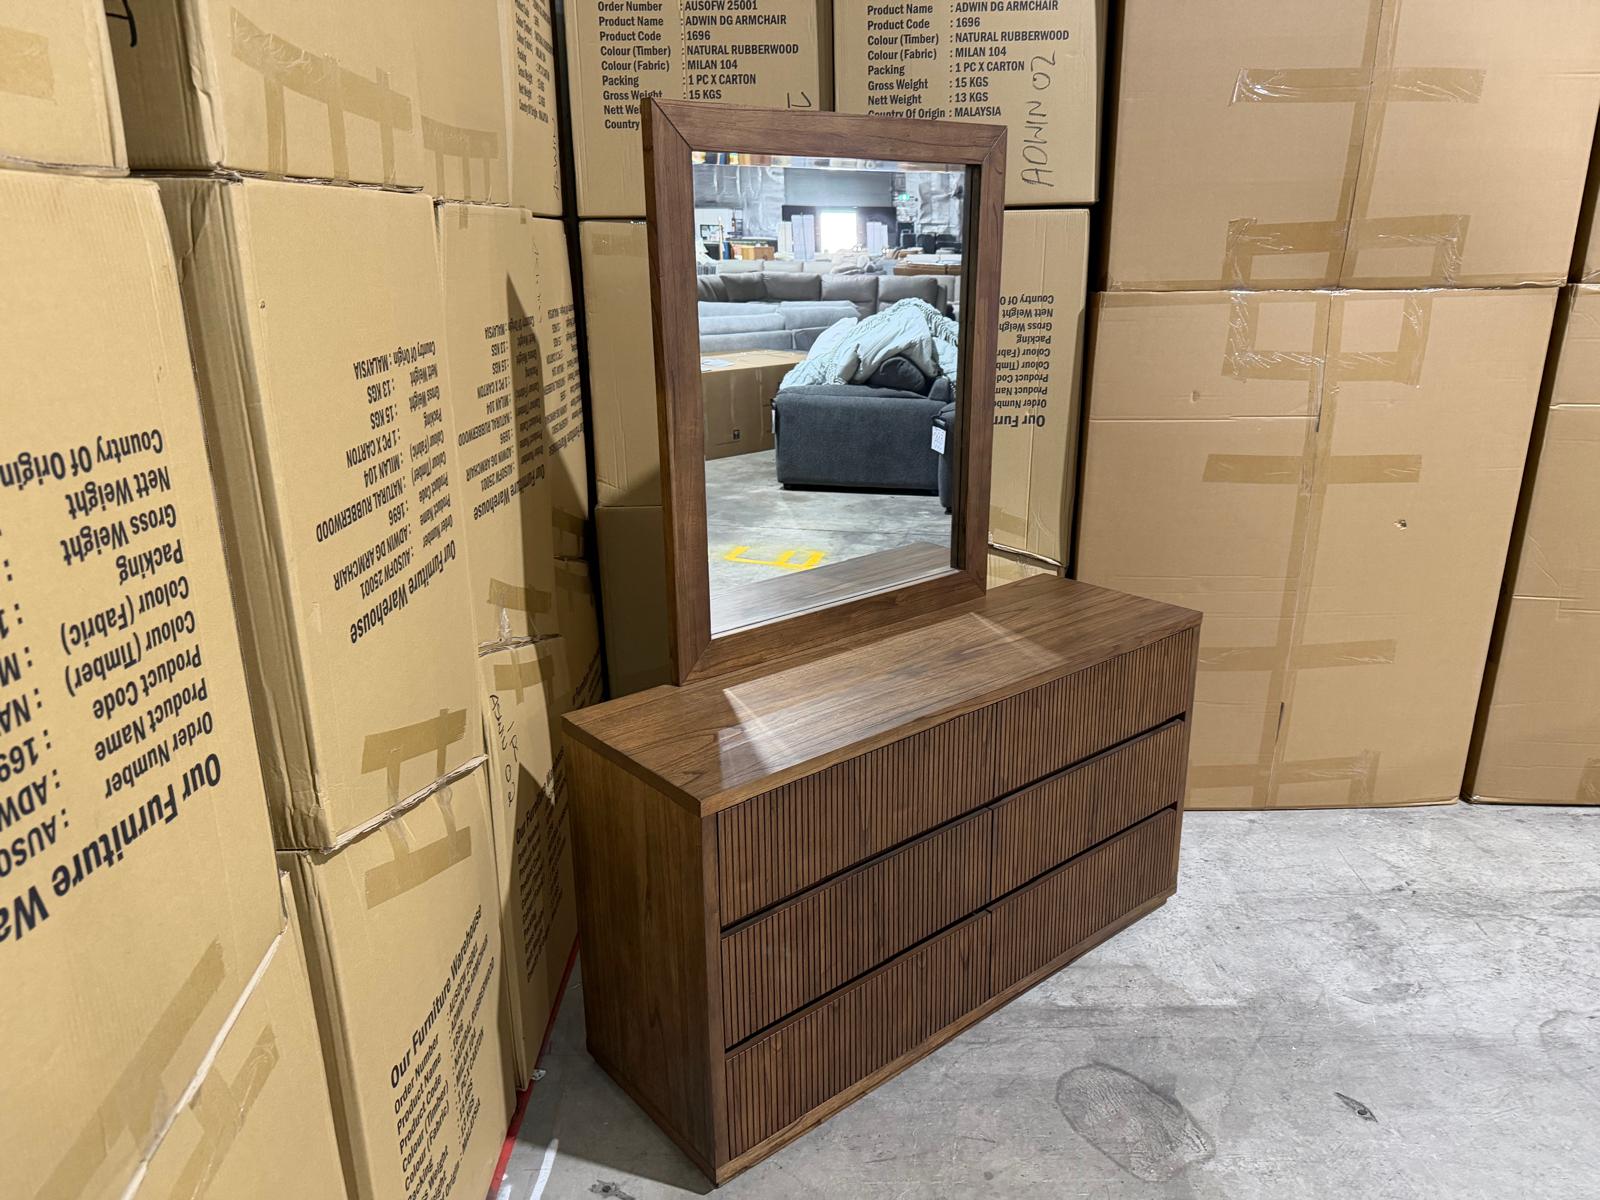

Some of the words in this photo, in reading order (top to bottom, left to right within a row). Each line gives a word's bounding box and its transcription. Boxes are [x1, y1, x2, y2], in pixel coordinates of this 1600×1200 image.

[598, 1, 624, 11] Order
[626, 1, 662, 11] Number
[684, 1, 725, 11] AUSOFW
[727, 0, 758, 10] 25001
[867, 4, 904, 15] Product
[906, 3, 933, 14] Name
[956, 1, 988, 12] ADWIN
[990, 1, 1004, 11] DG
[1006, 0, 1058, 11] ARMCHAIR
[598, 16, 635, 26] Product
[637, 16, 664, 26] Name
[686, 16, 717, 26] ADWIN
[720, 15, 733, 26] DG
[735, 15, 786, 25] ARMCHAIR
[868, 20, 904, 30] Product
[906, 19, 930, 29] Code
[956, 18, 980, 27] 1696
[600, 31, 636, 42] Product
[638, 31, 661, 41] Code
[687, 31, 710, 41] 1696
[868, 35, 898, 46] Colour
[900, 33, 939, 46] (Timber)
[955, 32, 998, 43] NATURAL
[1000, 30, 1069, 41] RUBBERWOOD
[601, 46, 631, 57] Colour
[633, 45, 671, 57] (Timber)
[687, 45, 729, 55] NATURAL
[732, 44, 799, 54] RUBBERWOOD
[868, 50, 898, 60] Colour
[900, 49, 937, 61] (Fabric)
[955, 47, 986, 58] MILAN
[988, 47, 1006, 57] 104
[602, 61, 632, 71] Colour
[634, 60, 670, 72] (Fabric)
[688, 60, 717, 70] MILAN
[719, 60, 738, 70] 104
[868, 65, 905, 76] Packing
[956, 63, 961, 72] 1
[963, 62, 976, 72] PC
[978, 62, 984, 72] X
[986, 61, 1025, 72] CARTON
[602, 76, 639, 88] Packing
[689, 75, 694, 85] 1
[696, 74, 709, 85] PC
[711, 74, 717, 85] X
[719, 74, 756, 84] CARTON
[868, 80, 894, 91] Gross
[896, 79, 928, 91] Weight
[956, 77, 967, 87] 15
[969, 77, 988, 87] KGS
[603, 90, 629, 100] Gross
[689, 90, 701, 99] 15
[703, 90, 721, 99] KGS
[868, 96, 888, 105] Nett
[889, 94, 922, 106] Weight
[955, 92, 967, 102] 13
[969, 92, 988, 102] KGS
[604, 105, 624, 115] Nett
[906, 109, 916, 118] Of
[918, 108, 945, 120] Origin
[954, 107, 1001, 118] MALAYSIA
[605, 120, 640, 130] Country
[1008, 296, 1017, 305] Of
[1020, 294, 1054, 304] Country
[1002, 308, 1032, 318] Weight
[1034, 308, 1053, 317] Nett
[999, 321, 1025, 332] Weigh
[1028, 322, 1052, 331] Gross
[1016, 334, 1051, 344] Packing
[997, 347, 1020, 358] (Fabr
[1022, 348, 1050, 357] Colour
[353, 355, 389, 380] MALAYSIA
[996, 360, 1019, 370] (Timb
[1021, 361, 1049, 369] Colour
[383, 379, 391, 396] 13
[996, 374, 1013, 383] Cod
[1015, 374, 1048, 382] Product
[367, 383, 382, 404] KGS
[1015, 387, 1047, 395] Product
[385, 405, 394, 424] 15
[993, 400, 1021, 408] Numbe
[1023, 399, 1046, 408] Order
[370, 409, 385, 430] KGS
[1022, 415, 1045, 427] Our
[96, 429, 164, 464] Country
[376, 438, 382, 454] X
[382, 434, 392, 450] PC
[392, 430, 397, 446] 1
[71, 446, 92, 477] Of
[346, 441, 376, 468] CARTON
[0, 452, 66, 490] Origin
[364, 462, 377, 488] 104
[379, 454, 400, 479] MILAN
[134, 466, 171, 498] Nett
[372, 477, 404, 509] NATURAL
[65, 477, 134, 520] Weight
[130, 504, 176, 535] Gross
[316, 498, 373, 542] RUBBERWOOD
[388, 503, 405, 526] 1696
[60, 520, 130, 566] Weight
[376, 541, 386, 561] DG
[386, 525, 408, 557] ADWIN
[444, 540, 456, 563] Our
[115, 539, 184, 586] Packing
[333, 548, 374, 591] ARMCHAIR
[384, 548, 411, 582] AUSOFW
[408, 550, 444, 594] Furniture
[139, 575, 190, 615] Colour
[360, 569, 384, 599] 25001
[60, 594, 134, 656] (Fabric)
[350, 584, 408, 643] Warehouse
[146, 610, 196, 651] Colour
[65, 632, 142, 697] (Timber)
[140, 644, 202, 693] Product
[92, 680, 139, 720] Code
[146, 677, 209, 732] Product
[95, 715, 147, 761] Name
[172, 711, 213, 752] Order
[0, 737, 39, 782] 169
[104, 740, 171, 799] Number
[182, 753, 222, 802] Our
[0, 774, 47, 833] ADW
[0, 814, 56, 878] AUSO
[51, 784, 179, 897] Furniture
[391, 1048, 411, 1088] Our
[412, 978, 450, 1055] Furniture
[451, 904, 481, 981] Warehouse
[395, 1077, 414, 1114] Order
[415, 1034, 438, 1081] Number
[397, 1083, 424, 1135] Product
[424, 1053, 441, 1088] Name
[400, 1101, 426, 1155] Product
[426, 1074, 441, 1105] Code
[403, 1129, 424, 1172] Colour
[425, 1080, 448, 1134] (Timber)
[405, 1147, 426, 1191] Colour
[427, 1100, 449, 1152] (Fabric)
